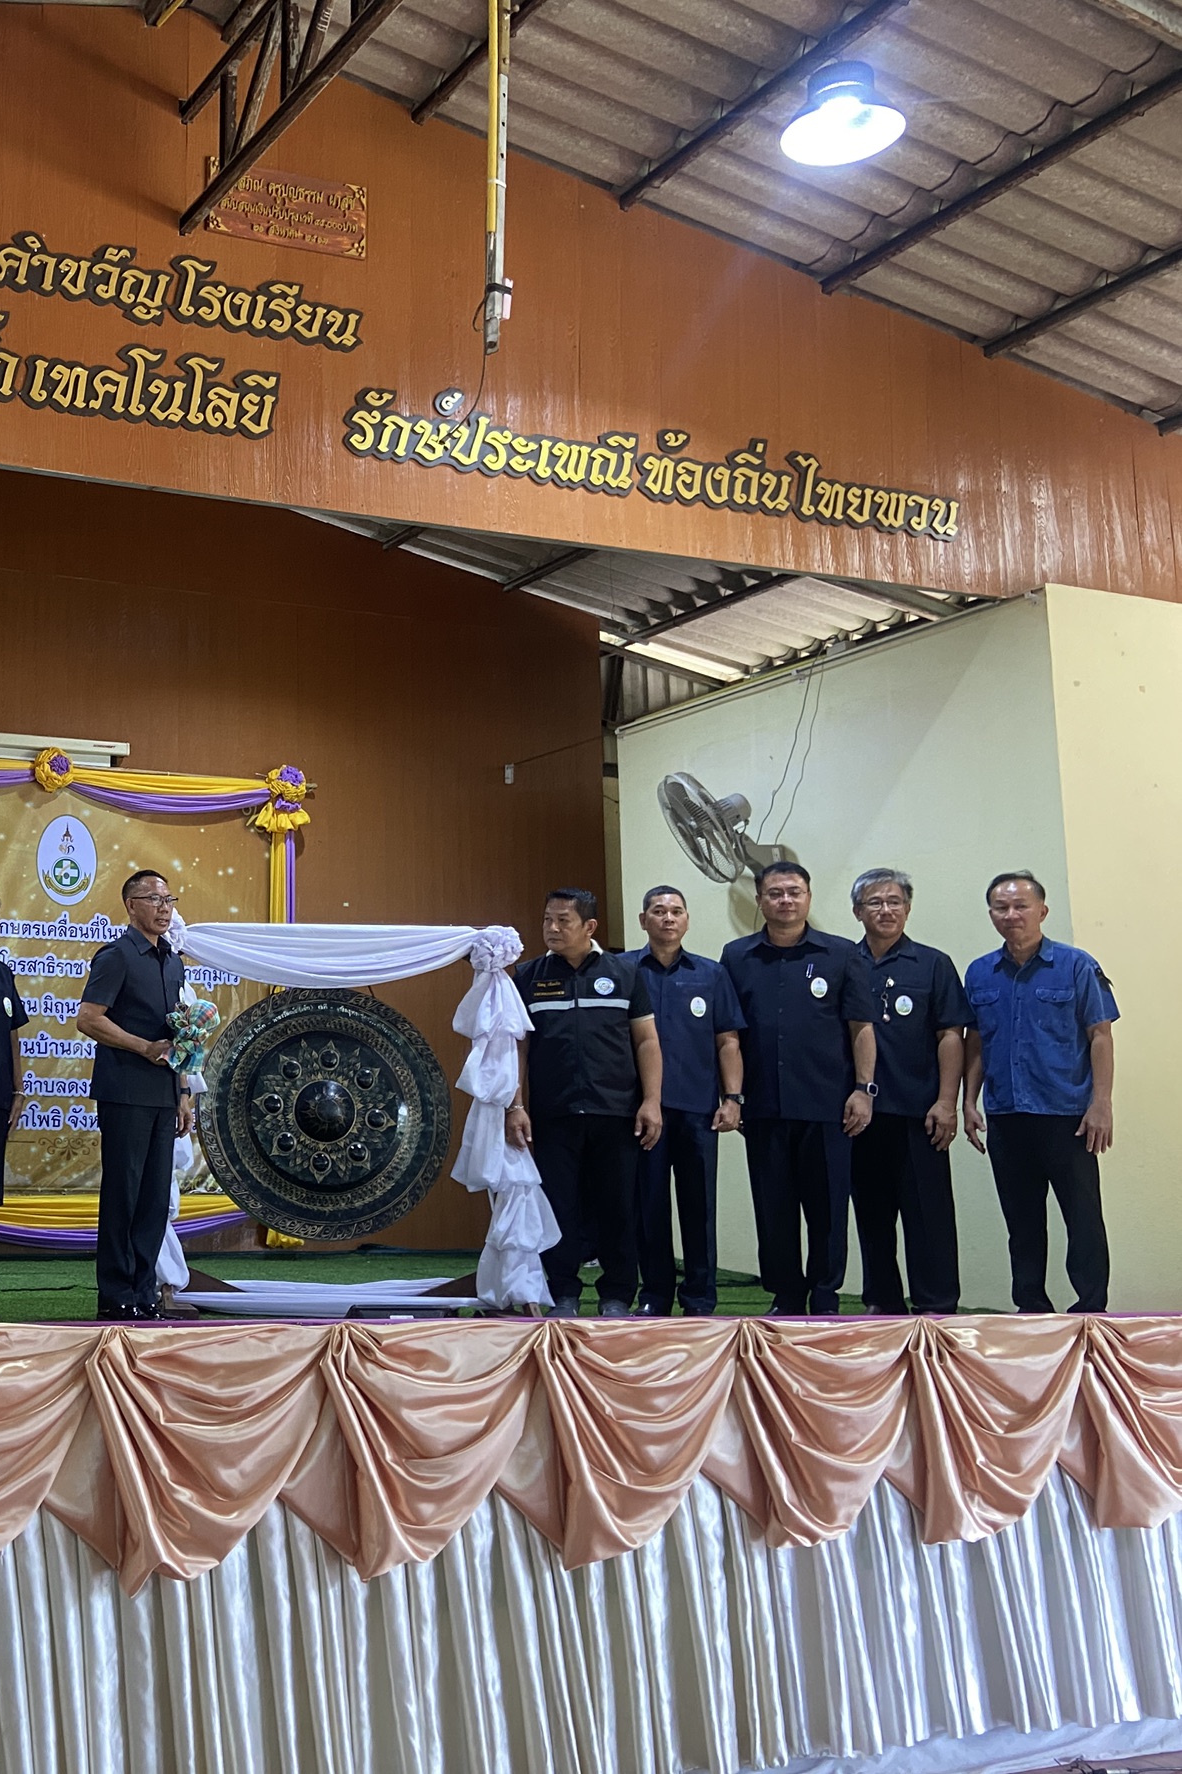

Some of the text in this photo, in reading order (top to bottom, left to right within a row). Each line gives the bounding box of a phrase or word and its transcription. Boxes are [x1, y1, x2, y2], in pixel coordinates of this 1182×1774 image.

[28, 348, 279, 435] เทคโนโลยี
[43, 994, 81, 1021] มิถุน
[19, 1033, 97, 1057] นบ้านดง
[23, 1073, 91, 1094] ตำบลดง
